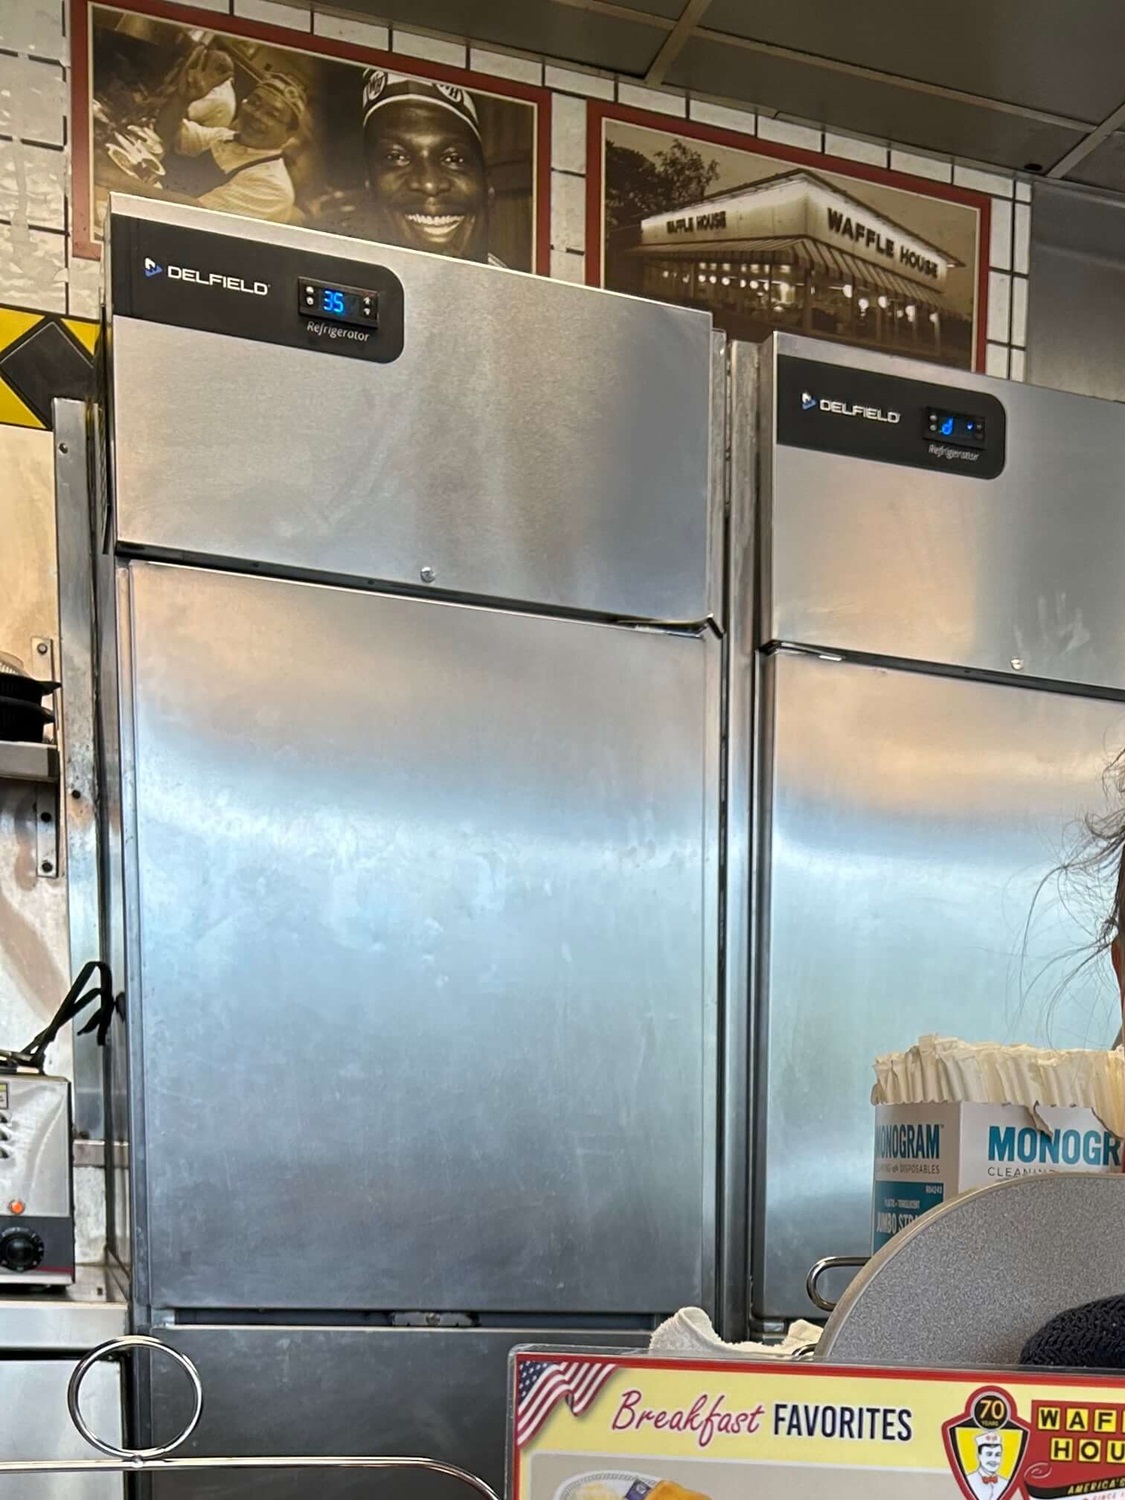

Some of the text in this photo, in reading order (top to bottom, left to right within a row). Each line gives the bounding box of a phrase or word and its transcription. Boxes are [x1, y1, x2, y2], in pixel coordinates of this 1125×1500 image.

[667, 211, 726, 234] WAFFLE HOUSE
[827, 208, 939, 279] WAFFLE HOUSE
[168, 266, 268, 296] DELFIELD
[322, 290, 344, 314] 35
[306, 320, 370, 342] Refrigerator
[820, 399, 900, 424] DELFIELD
[928, 444, 979, 461] Refrigerator
[876, 1124, 940, 1160] MONOGRAM
[610, 1388, 913, 1450] Breakfast FAVORITES
[979, 1398, 1003, 1420] 70
[981, 1419, 999, 1427] YEARS
[1067, 1474, 1125, 1497] AMERICA'S
